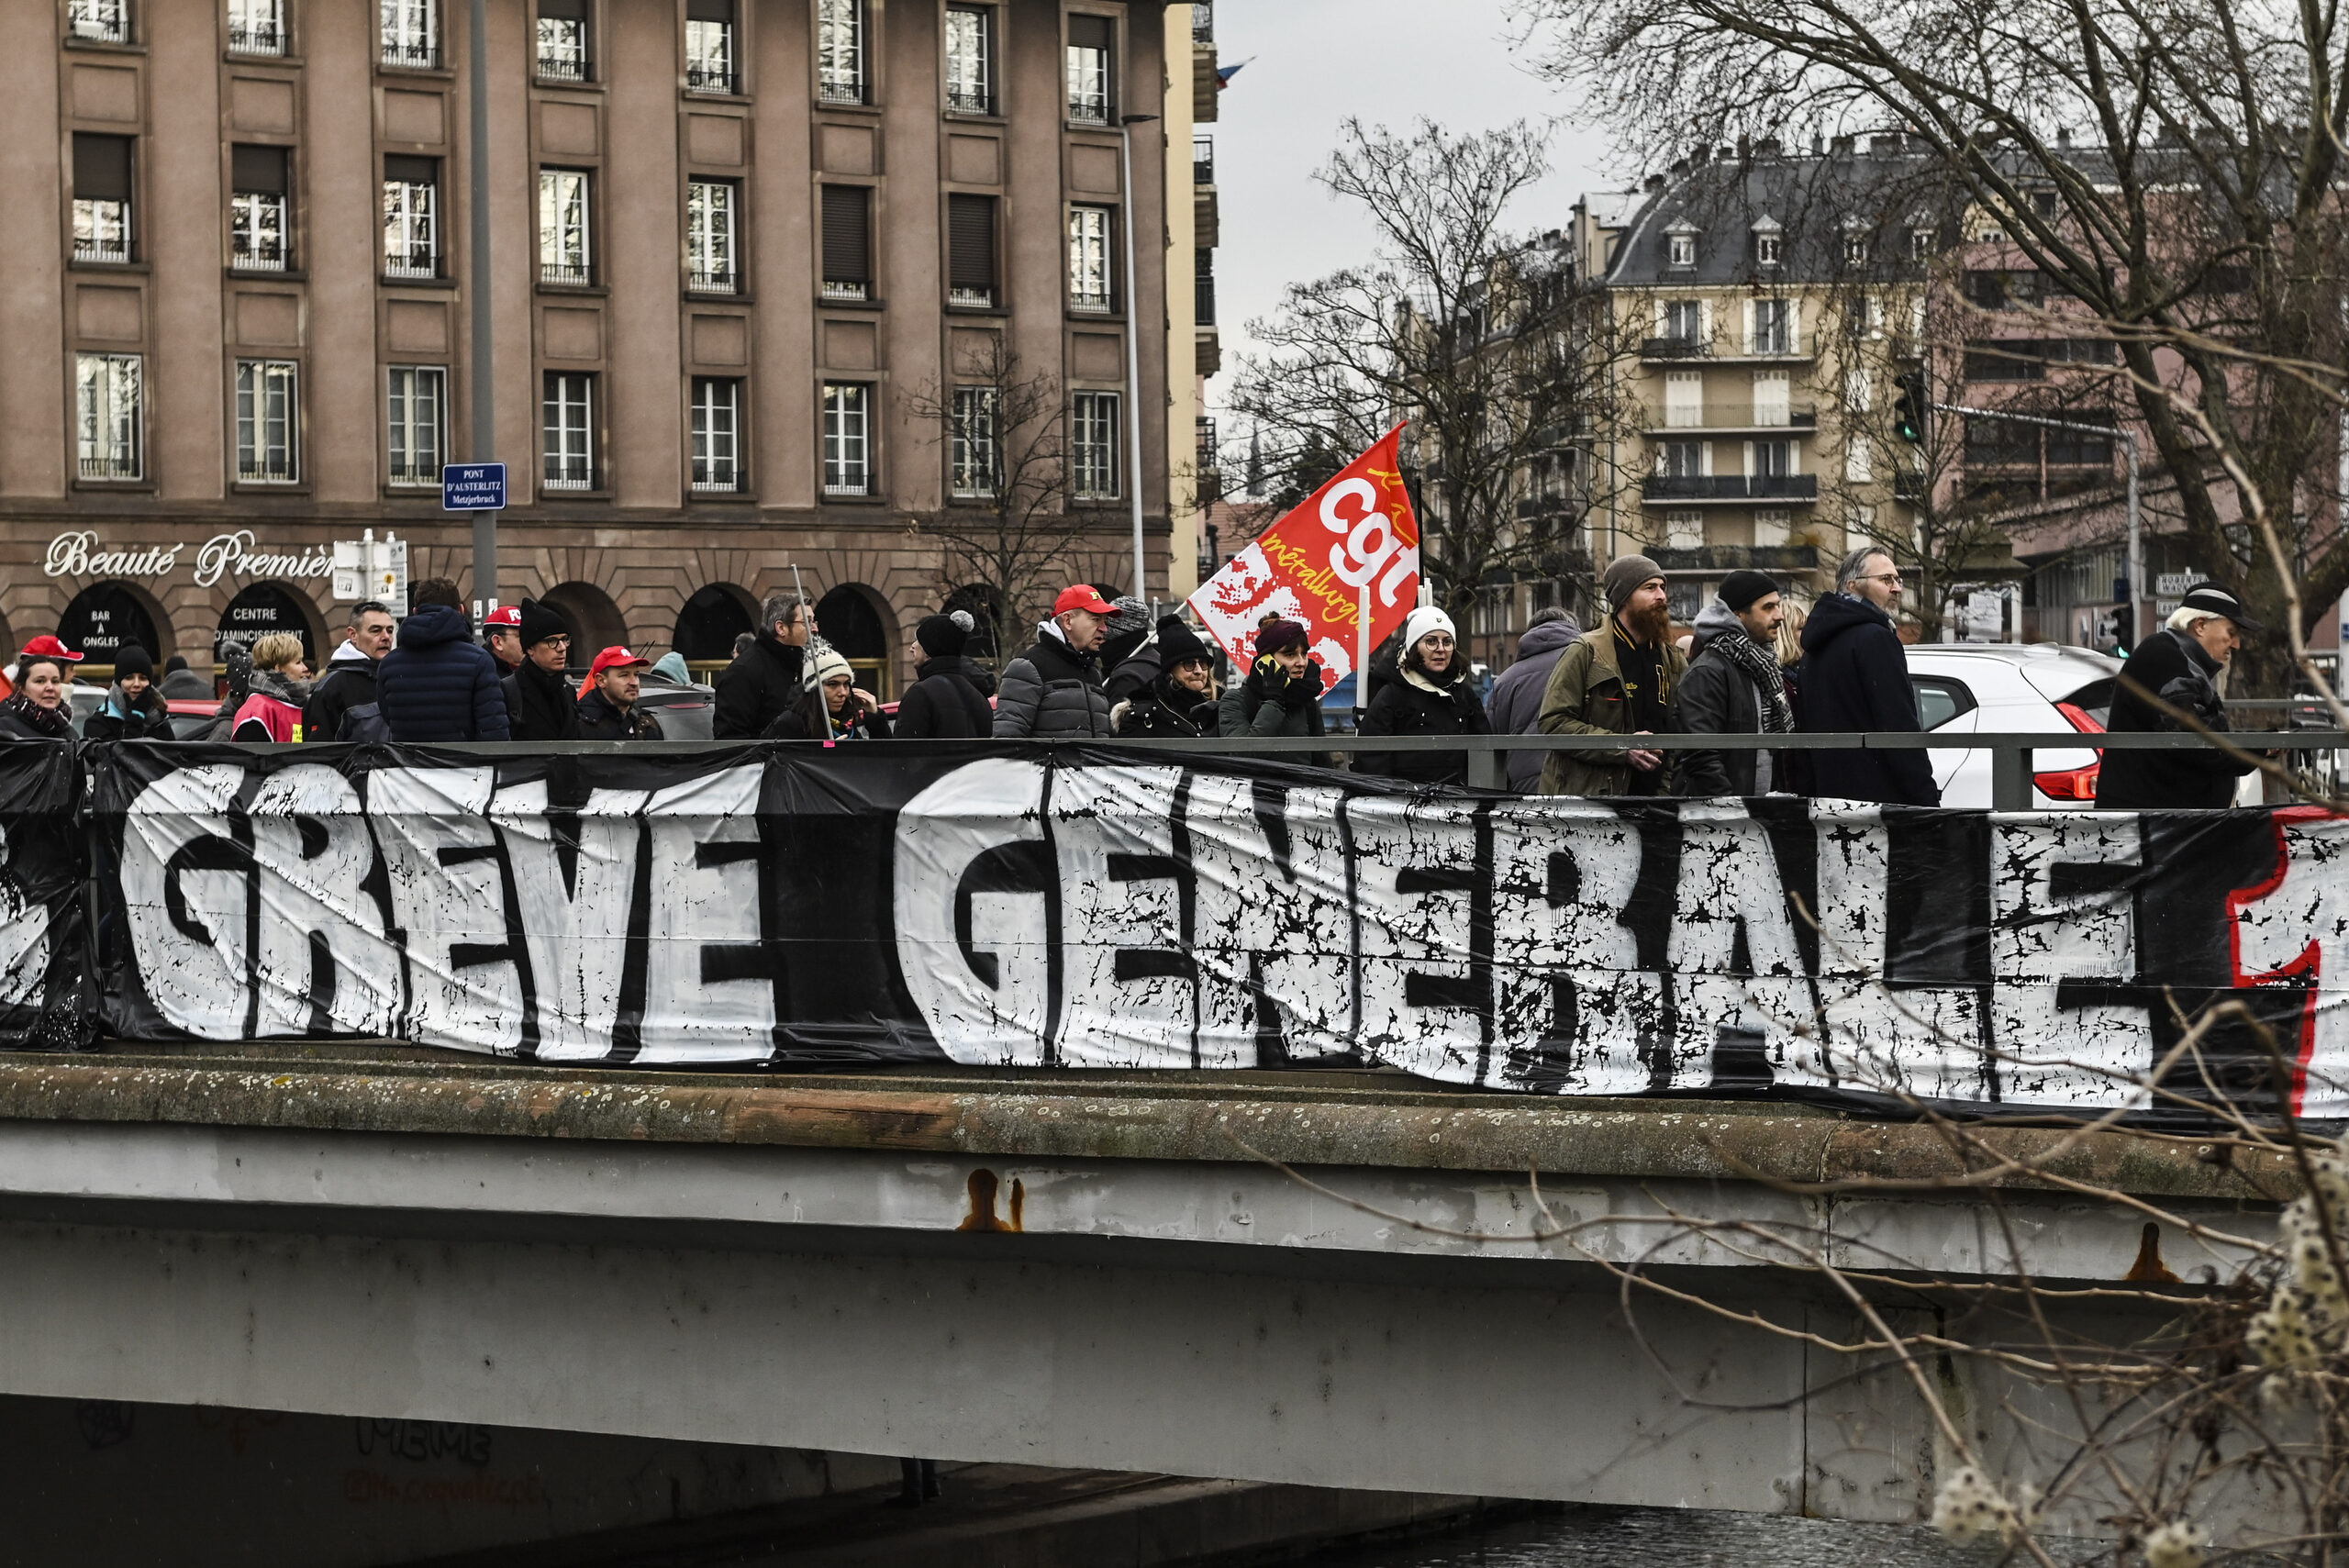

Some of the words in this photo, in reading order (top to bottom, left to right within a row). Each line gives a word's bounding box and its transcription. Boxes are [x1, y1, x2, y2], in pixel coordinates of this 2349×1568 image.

[463, 470, 484, 479] PONT
[447, 482, 502, 492] D'AUSTERLITZ
[452, 494, 496, 506] Metzjerbruck
[1319, 477, 1419, 608] cgt
[44, 530, 184, 577] Beauté
[193, 529, 335, 587] Premièr
[1261, 532, 1375, 631] métallurgi
[91, 610, 110, 622] BAR
[233, 607, 277, 620] CENTRE
[83, 636, 119, 648] ONGLES
[121, 762, 776, 1063] GREVE
[893, 758, 2153, 1110] GENERALE
